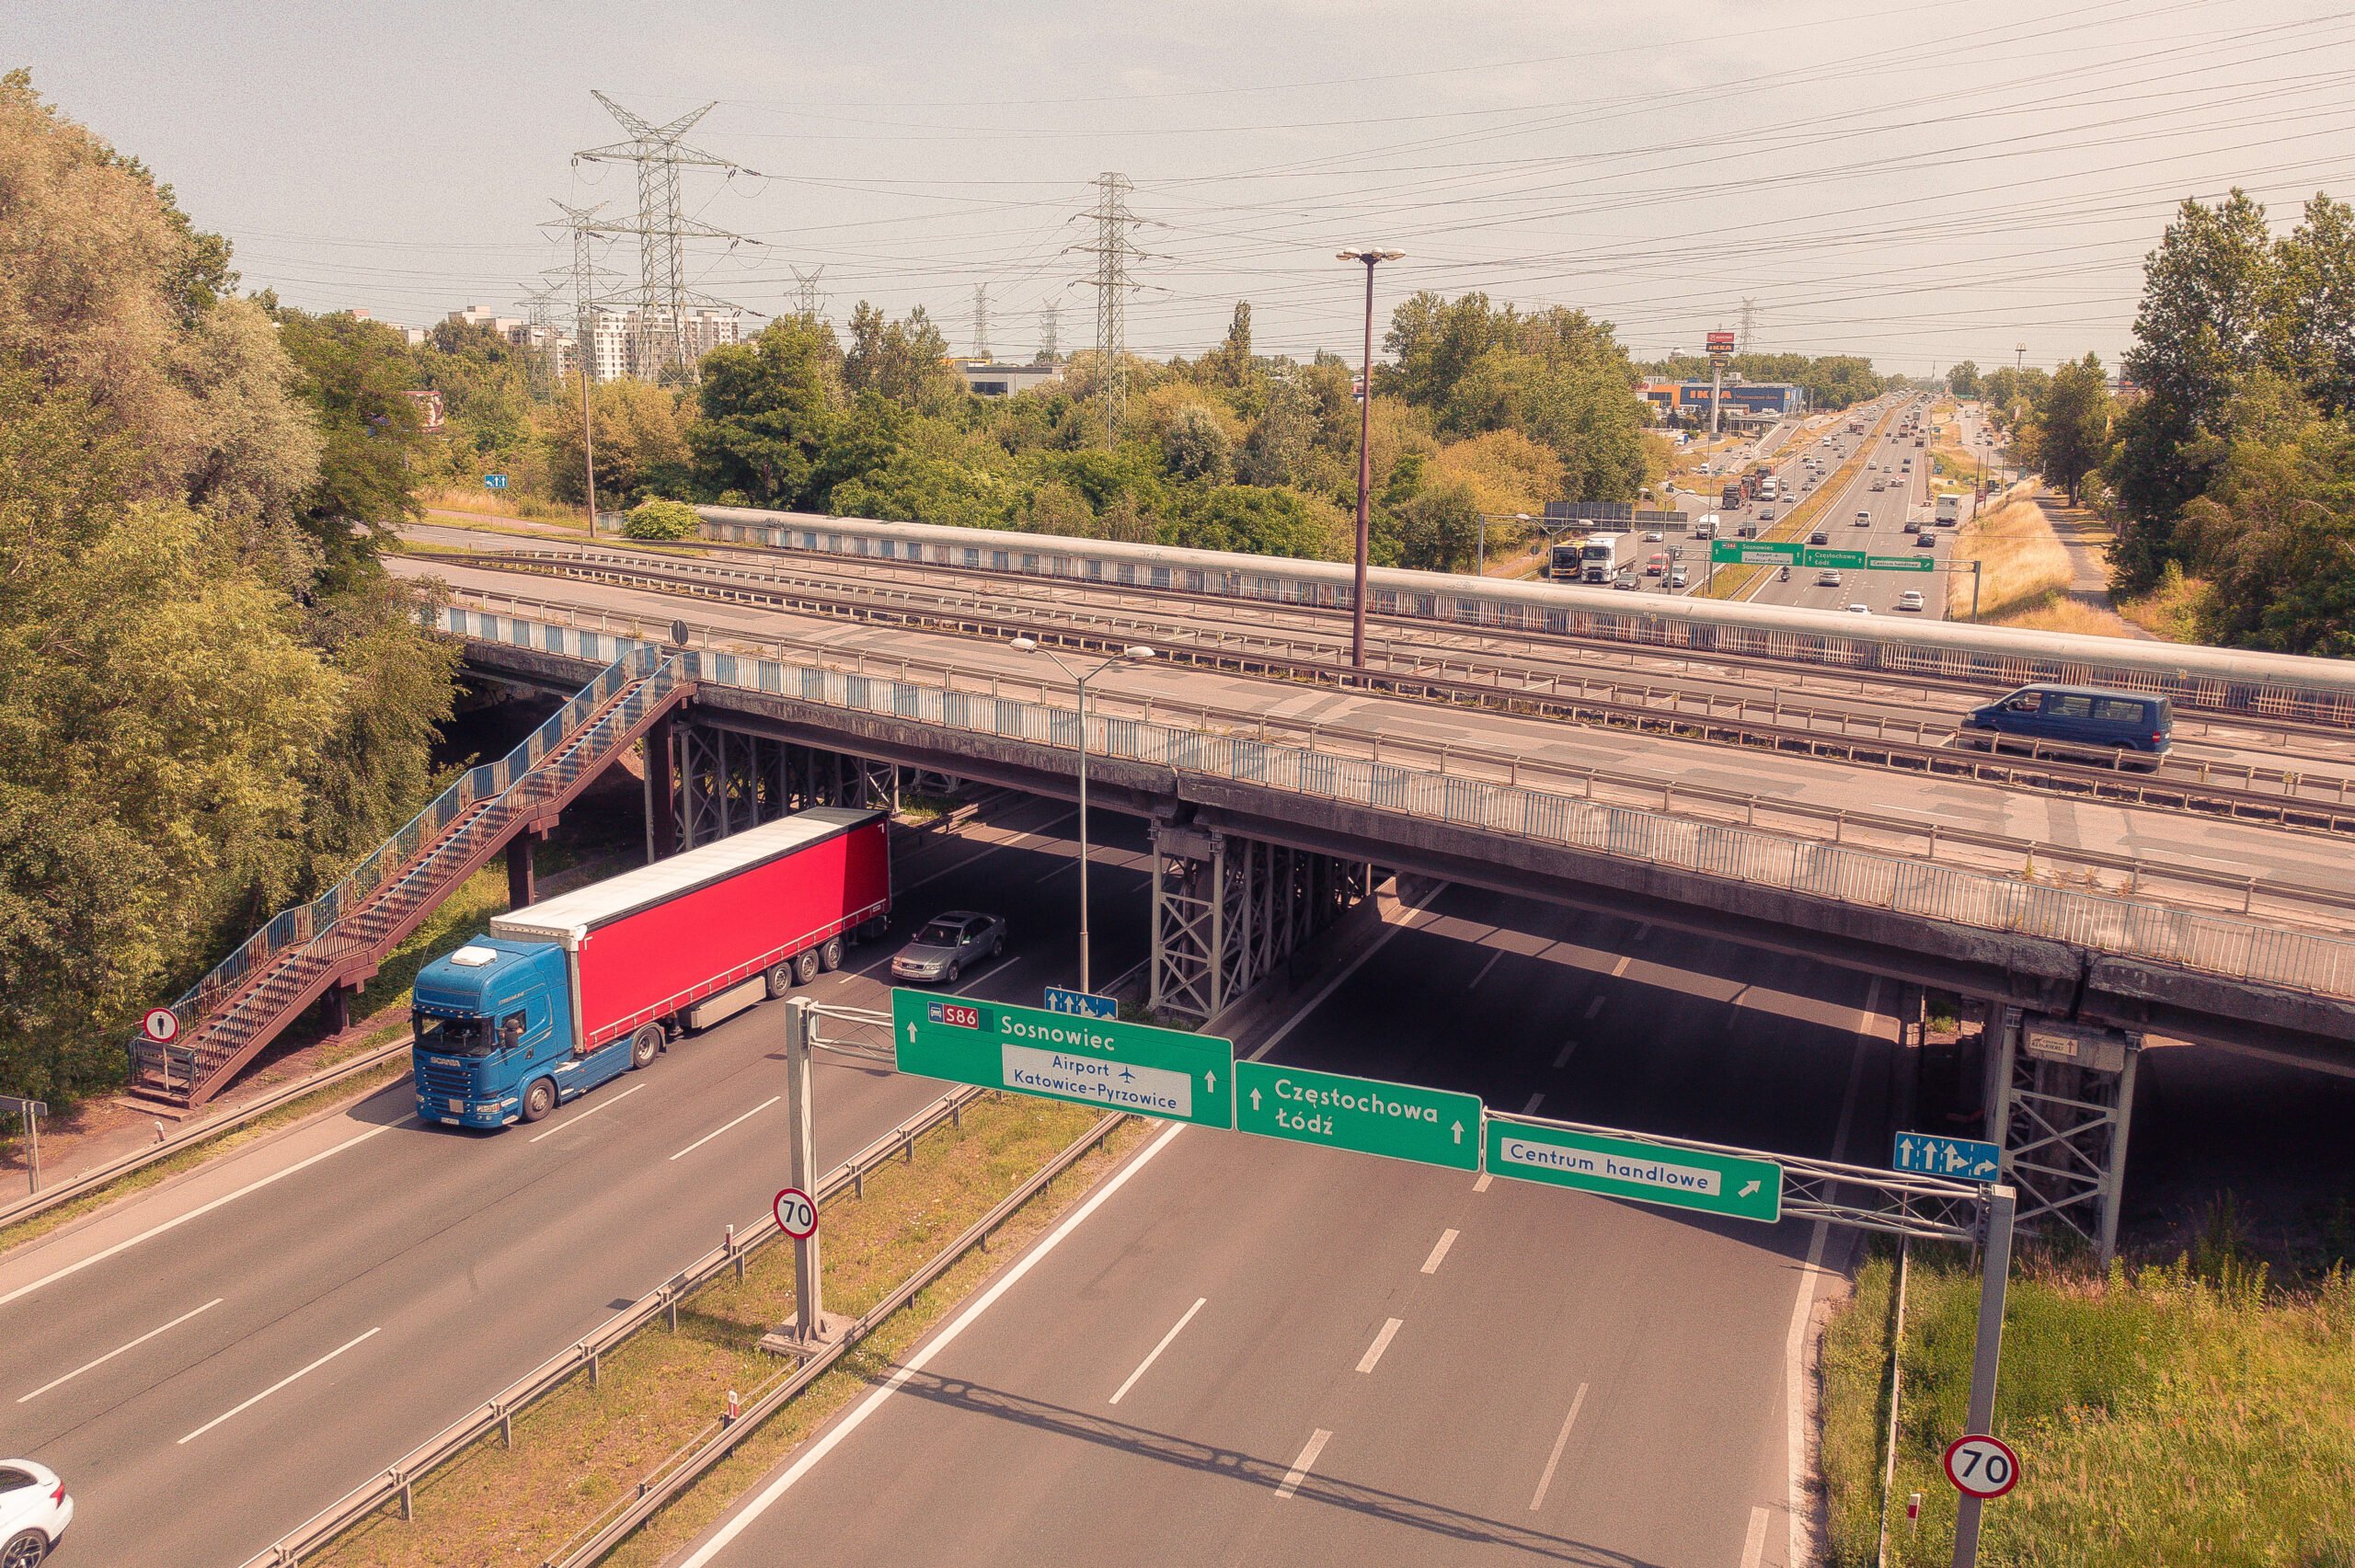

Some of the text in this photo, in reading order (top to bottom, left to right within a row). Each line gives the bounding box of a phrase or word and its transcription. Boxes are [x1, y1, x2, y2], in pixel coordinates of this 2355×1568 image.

[947, 1008, 977, 1025] S86
[1001, 1015, 1115, 1051] Sosnowiec
[431, 1057, 460, 1067] SCANIA
[1052, 1055, 1109, 1077] Airport
[1014, 1069, 1178, 1109] Katowice-Pyrzowice
[1274, 1079, 1439, 1123] Częstochowa
[1275, 1107, 1334, 1136] Łódź
[1511, 1144, 1709, 1189] Centrum handlowe
[783, 1199, 811, 1226] 70
[1961, 1448, 2008, 1483] 70
